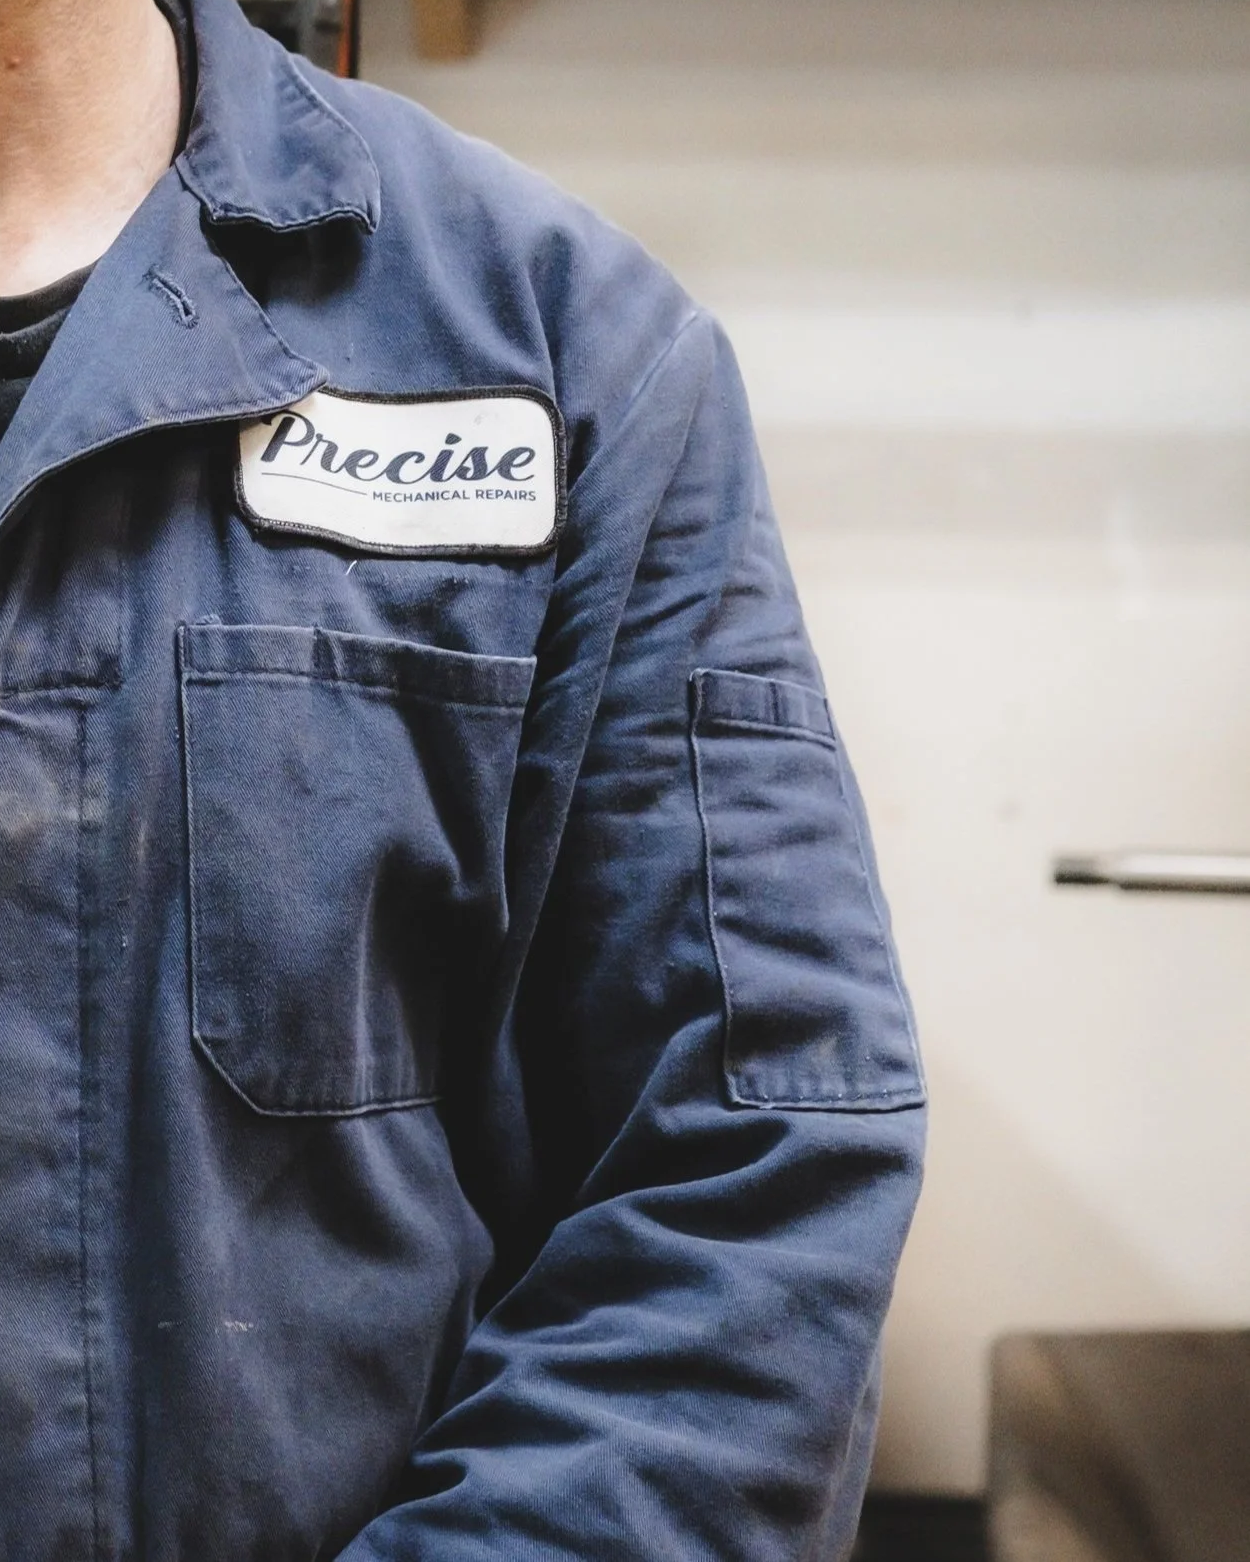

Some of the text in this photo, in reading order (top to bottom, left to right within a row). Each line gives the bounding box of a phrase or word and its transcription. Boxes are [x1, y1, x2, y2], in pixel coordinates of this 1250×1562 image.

[260, 409, 536, 485] Precise
[372, 488, 537, 503] MECHANICAL REPAIRS
